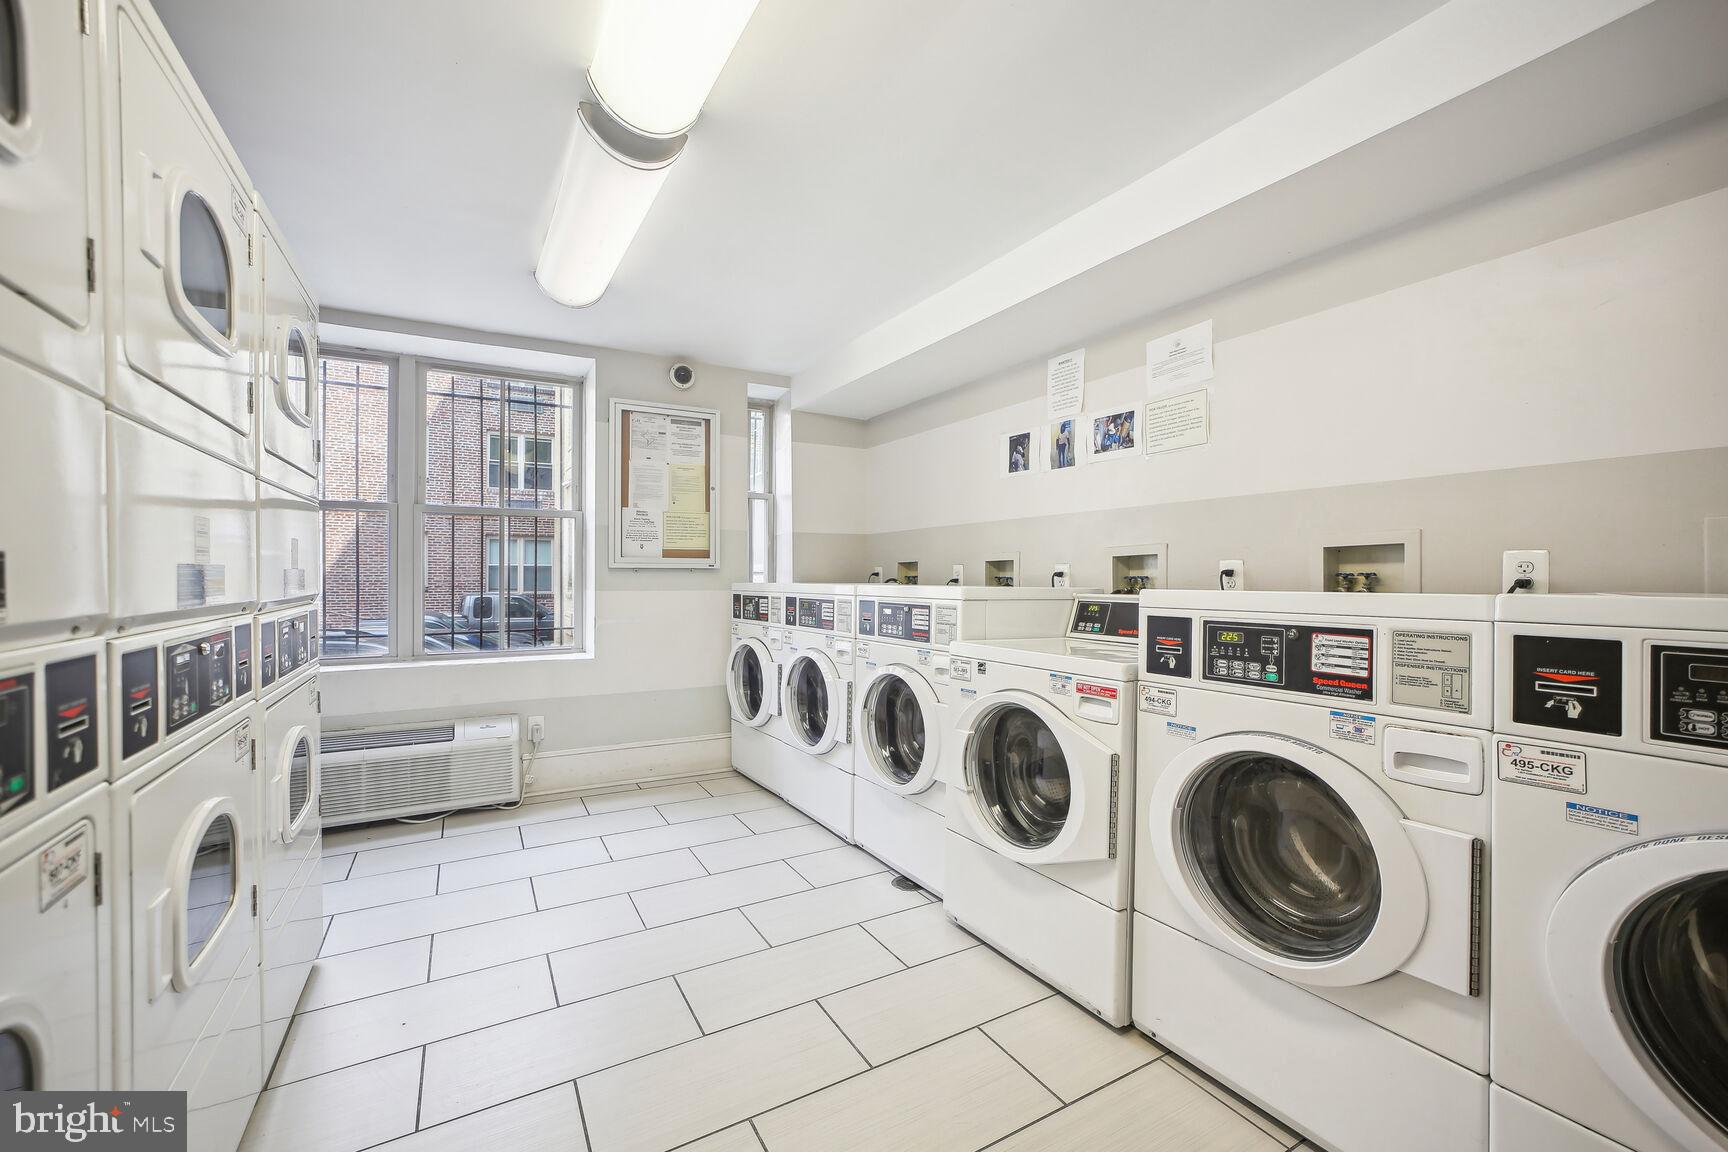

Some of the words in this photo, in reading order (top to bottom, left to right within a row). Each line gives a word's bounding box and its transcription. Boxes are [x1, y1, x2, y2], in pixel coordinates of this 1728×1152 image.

[1221, 632, 1239, 641] 225
[1426, 634, 1468, 642] INSTRUCTIONS
[1426, 665, 1468, 673] INSTRUCTIONS
[1313, 677, 1339, 686] Speed
[1340, 680, 1368, 689] Queen
[1316, 684, 1344, 693] Commercial
[1344, 687, 1362, 695] Washer
[1144, 696, 1172, 706] 494-CKG
[1510, 758, 1574, 776] 495-CKG
[1576, 804, 1629, 820] NOTICE
[1617, 843, 1650, 857] WHEN
[1652, 837, 1686, 848] DONE
